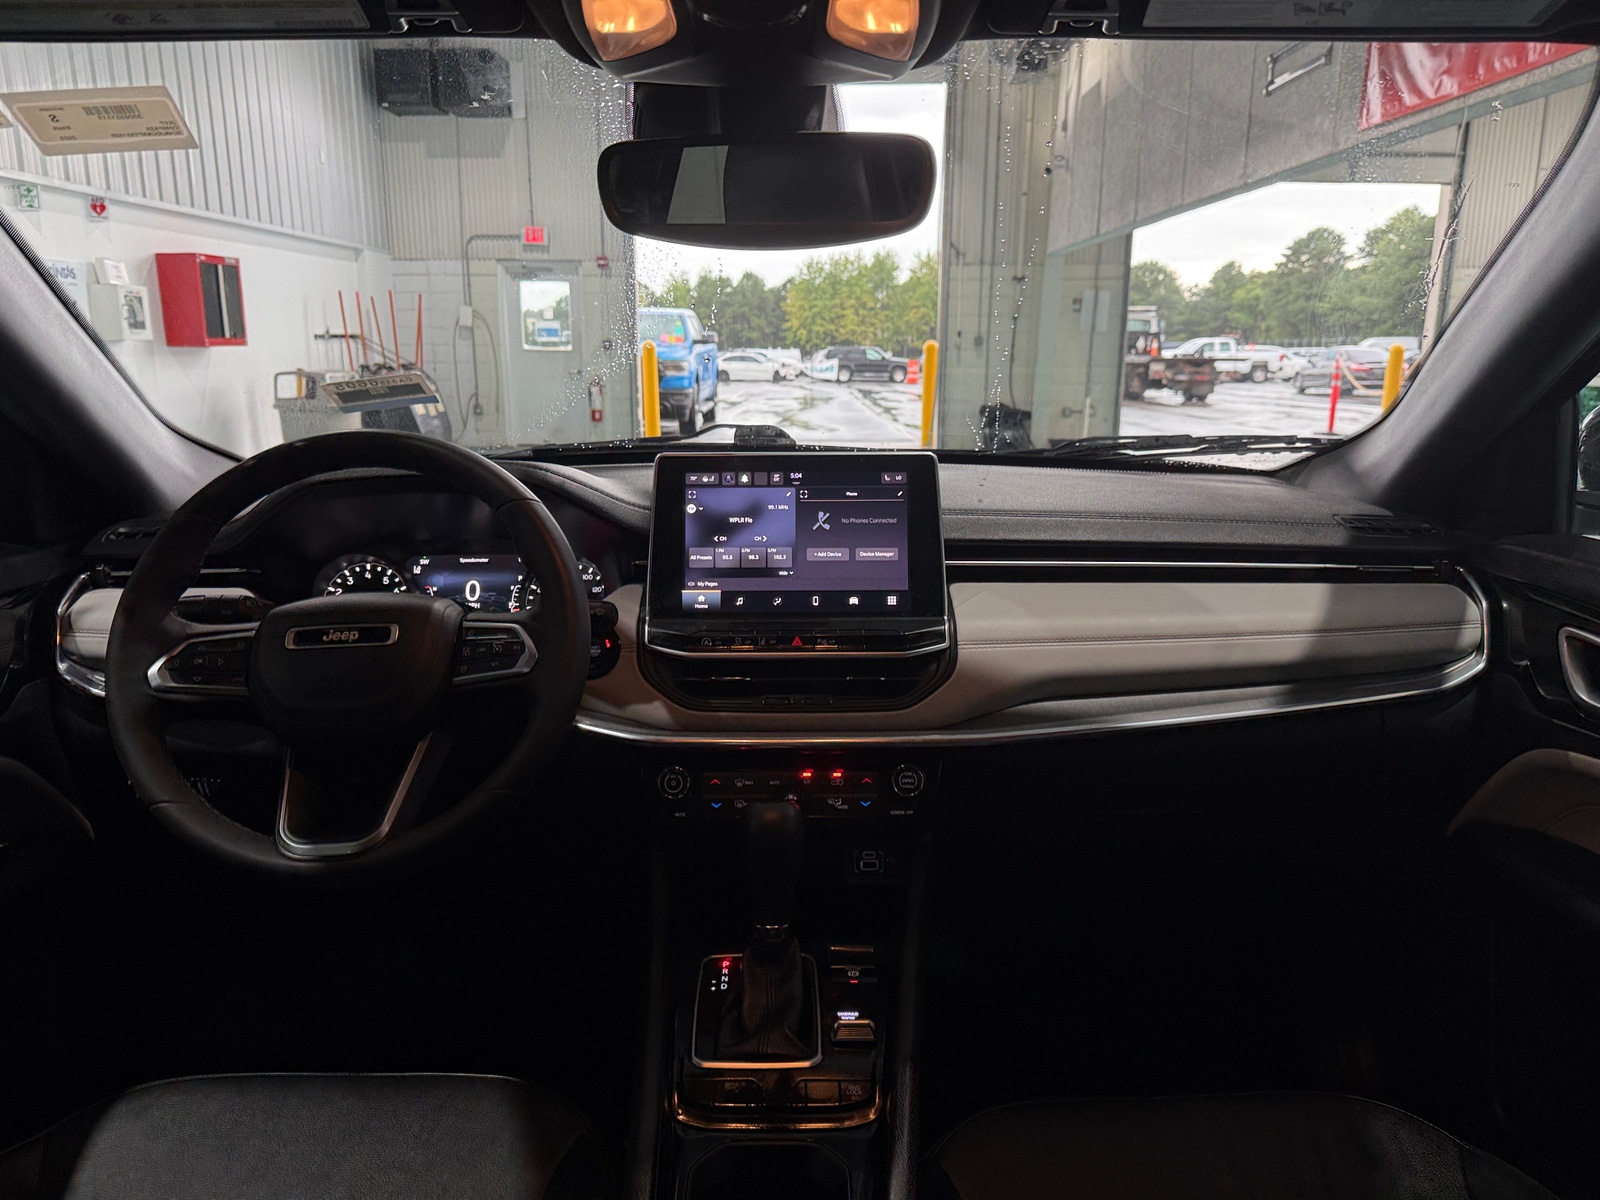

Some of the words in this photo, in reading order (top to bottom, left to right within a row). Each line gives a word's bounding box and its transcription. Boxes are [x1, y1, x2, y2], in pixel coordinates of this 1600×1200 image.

[90, 196, 105, 204] AED
[526, 227, 544, 242] EXIT
[365, 571, 372, 579] 4
[346, 577, 354, 585] 3
[382, 576, 389, 585] 5
[465, 579, 481, 602] 0
[322, 629, 359, 643] Jeep
[722, 960, 730, 968] P
[720, 982, 728, 991] D
